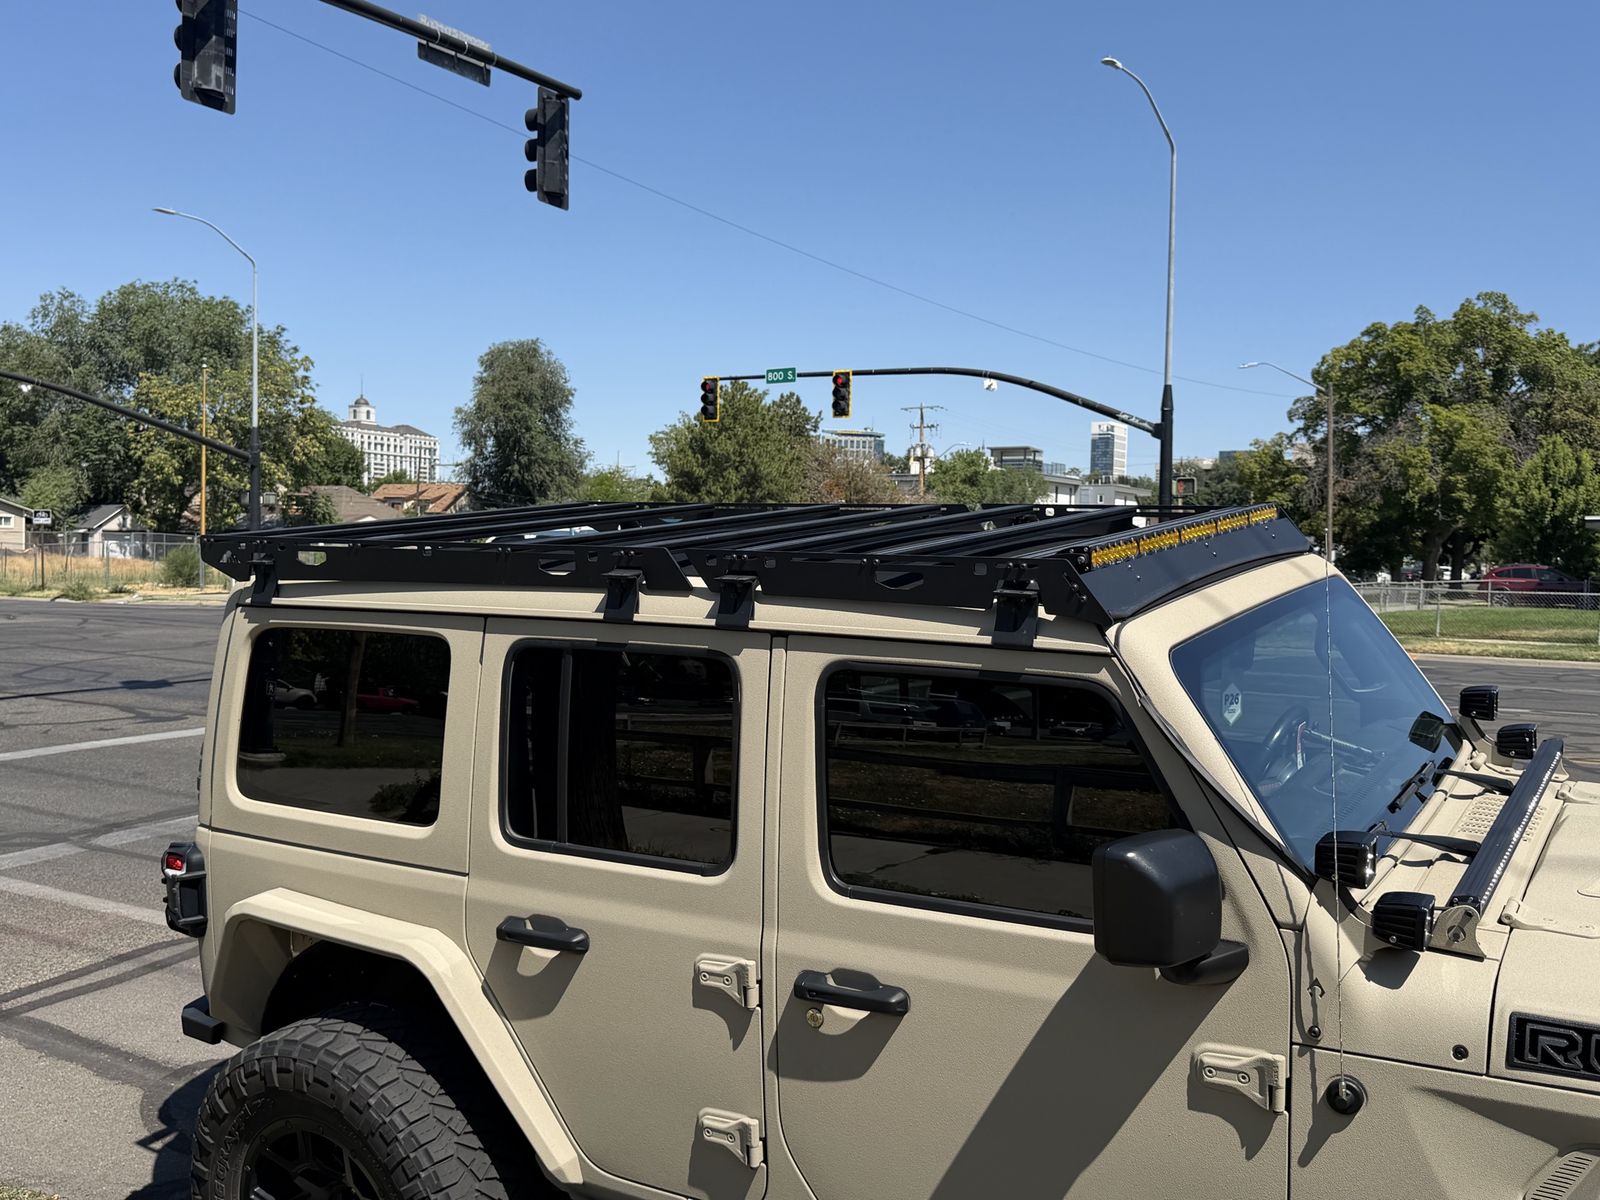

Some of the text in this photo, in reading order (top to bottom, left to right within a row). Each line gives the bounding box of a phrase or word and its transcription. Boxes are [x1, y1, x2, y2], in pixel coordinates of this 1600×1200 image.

[768, 371, 784, 381] 800
[1224, 693, 1240, 706] P26
[1524, 1022, 1600, 1073] R
